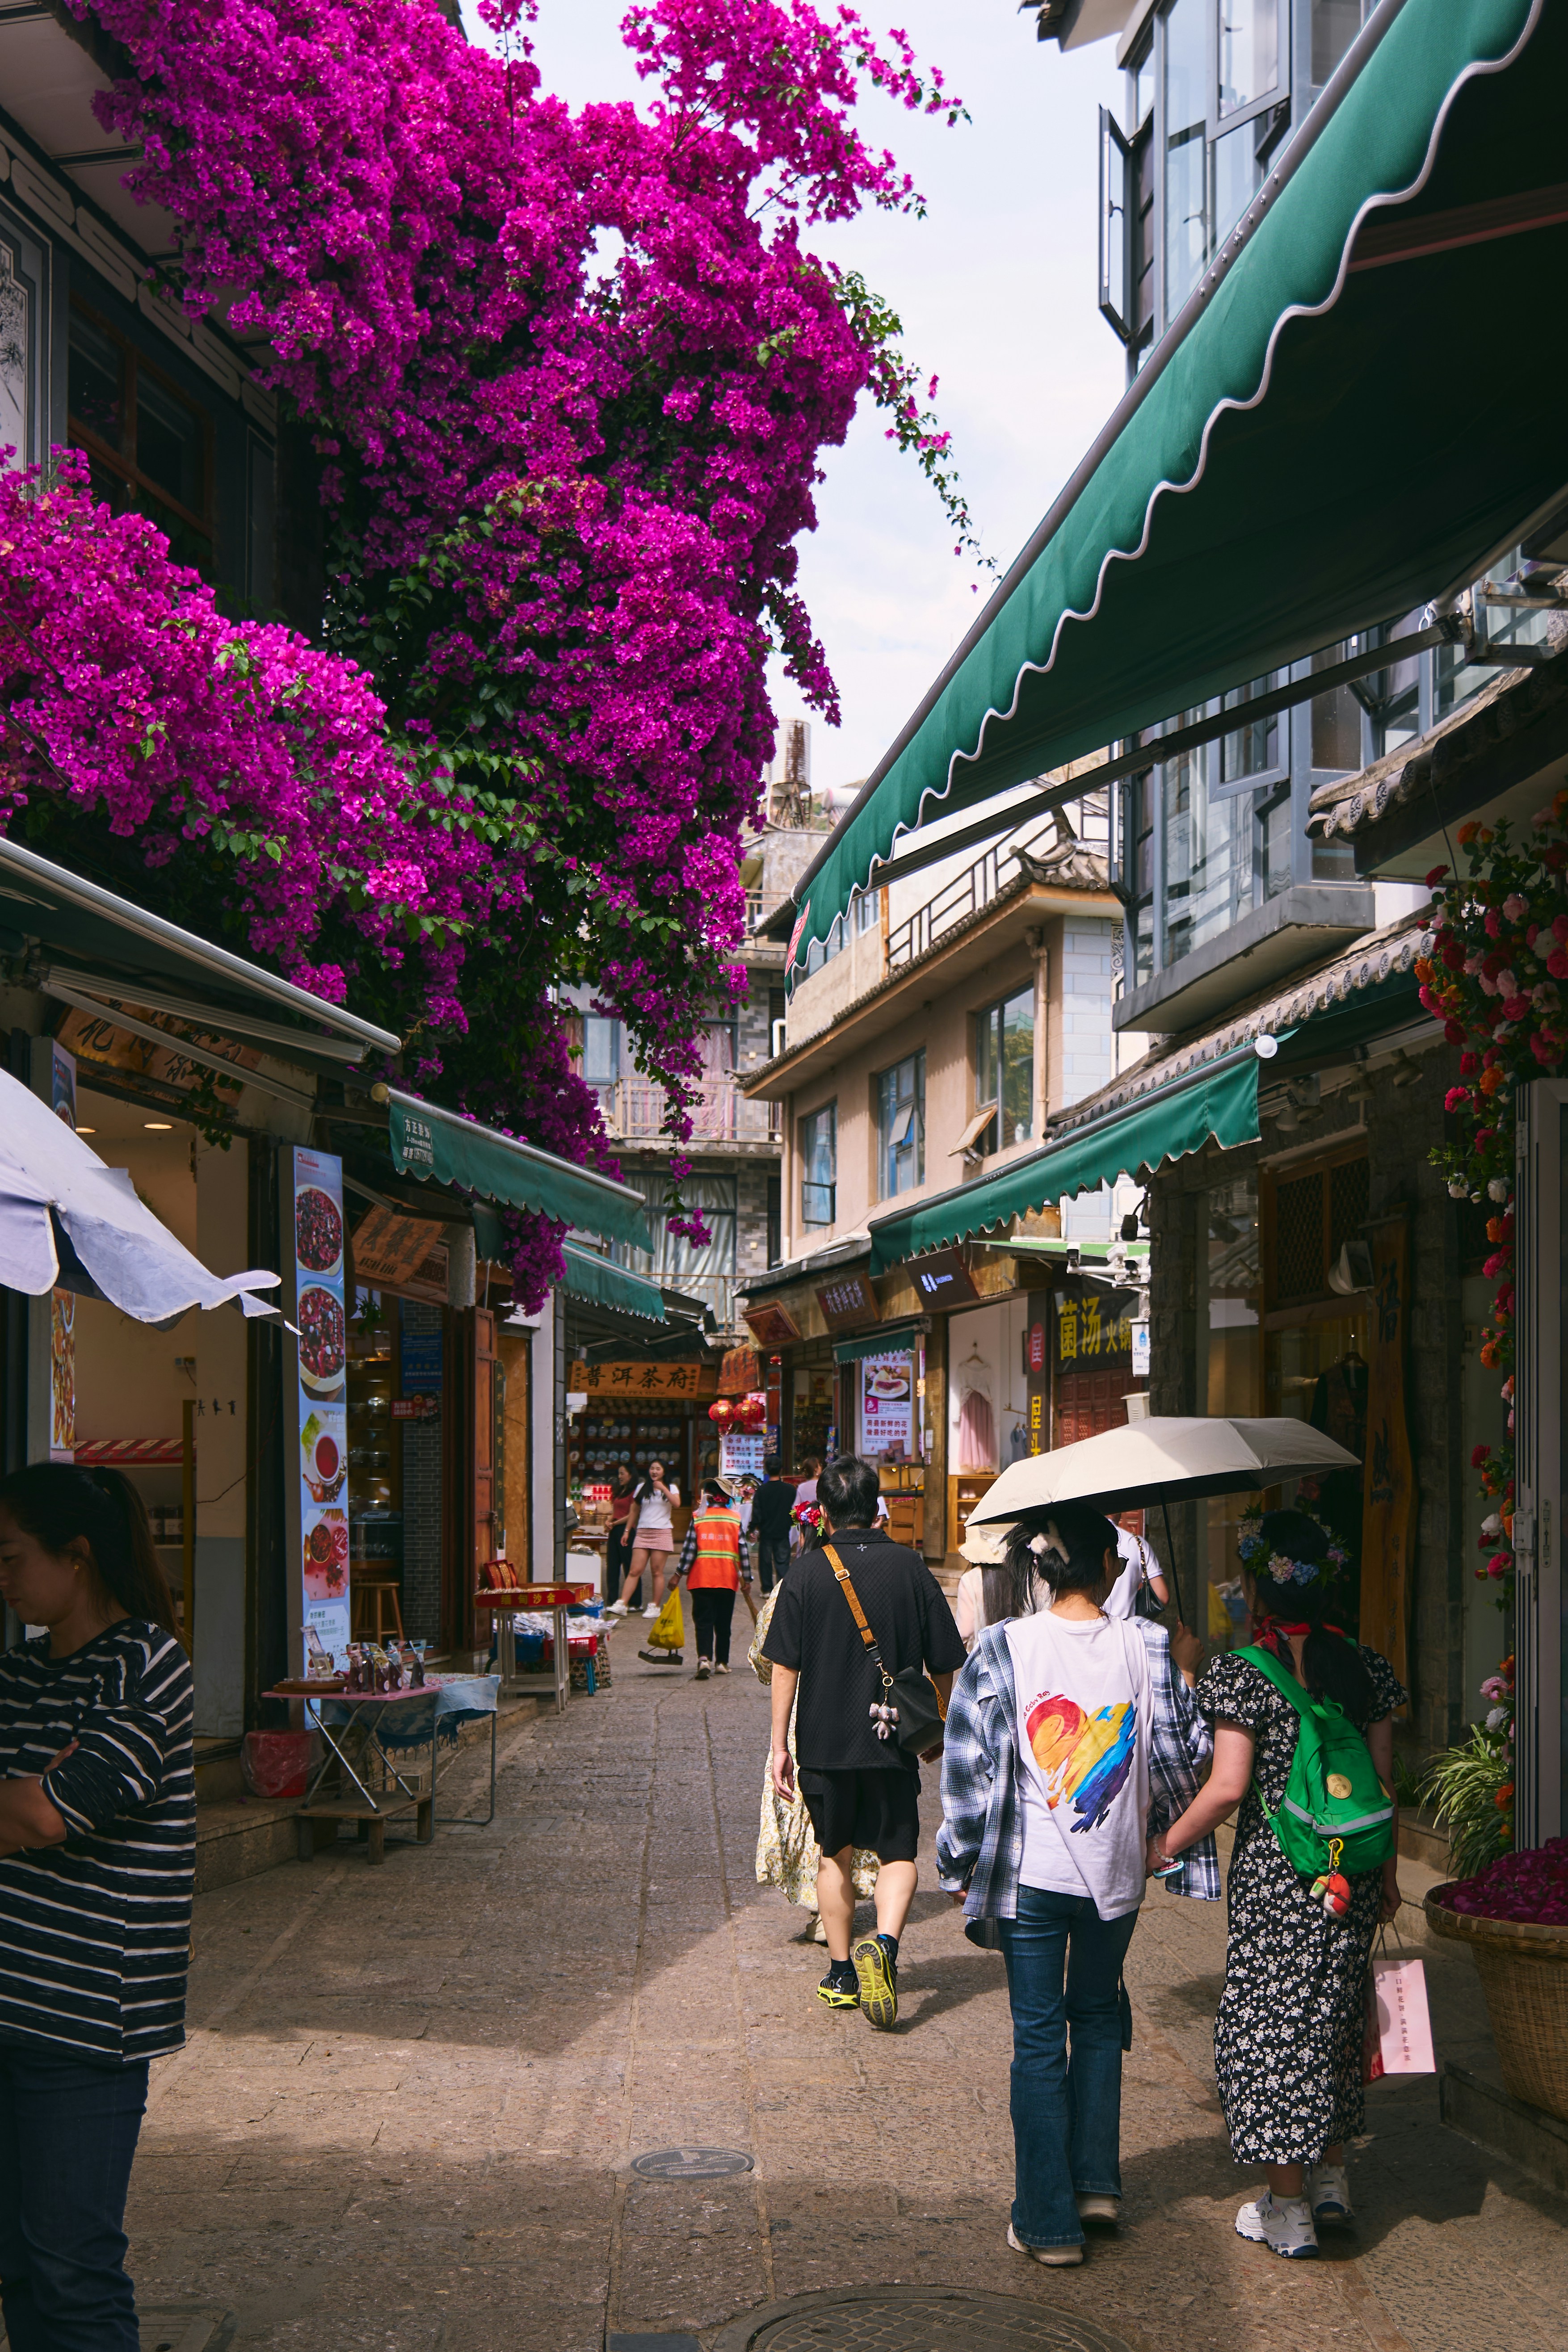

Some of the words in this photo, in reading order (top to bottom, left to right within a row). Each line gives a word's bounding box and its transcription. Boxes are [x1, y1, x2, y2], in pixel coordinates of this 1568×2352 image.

[582, 1366, 690, 1390] 普洱茶府
[501, 1593, 555, 1605] 缅甸沙金
[1037, 1691, 1050, 1699] Ray
